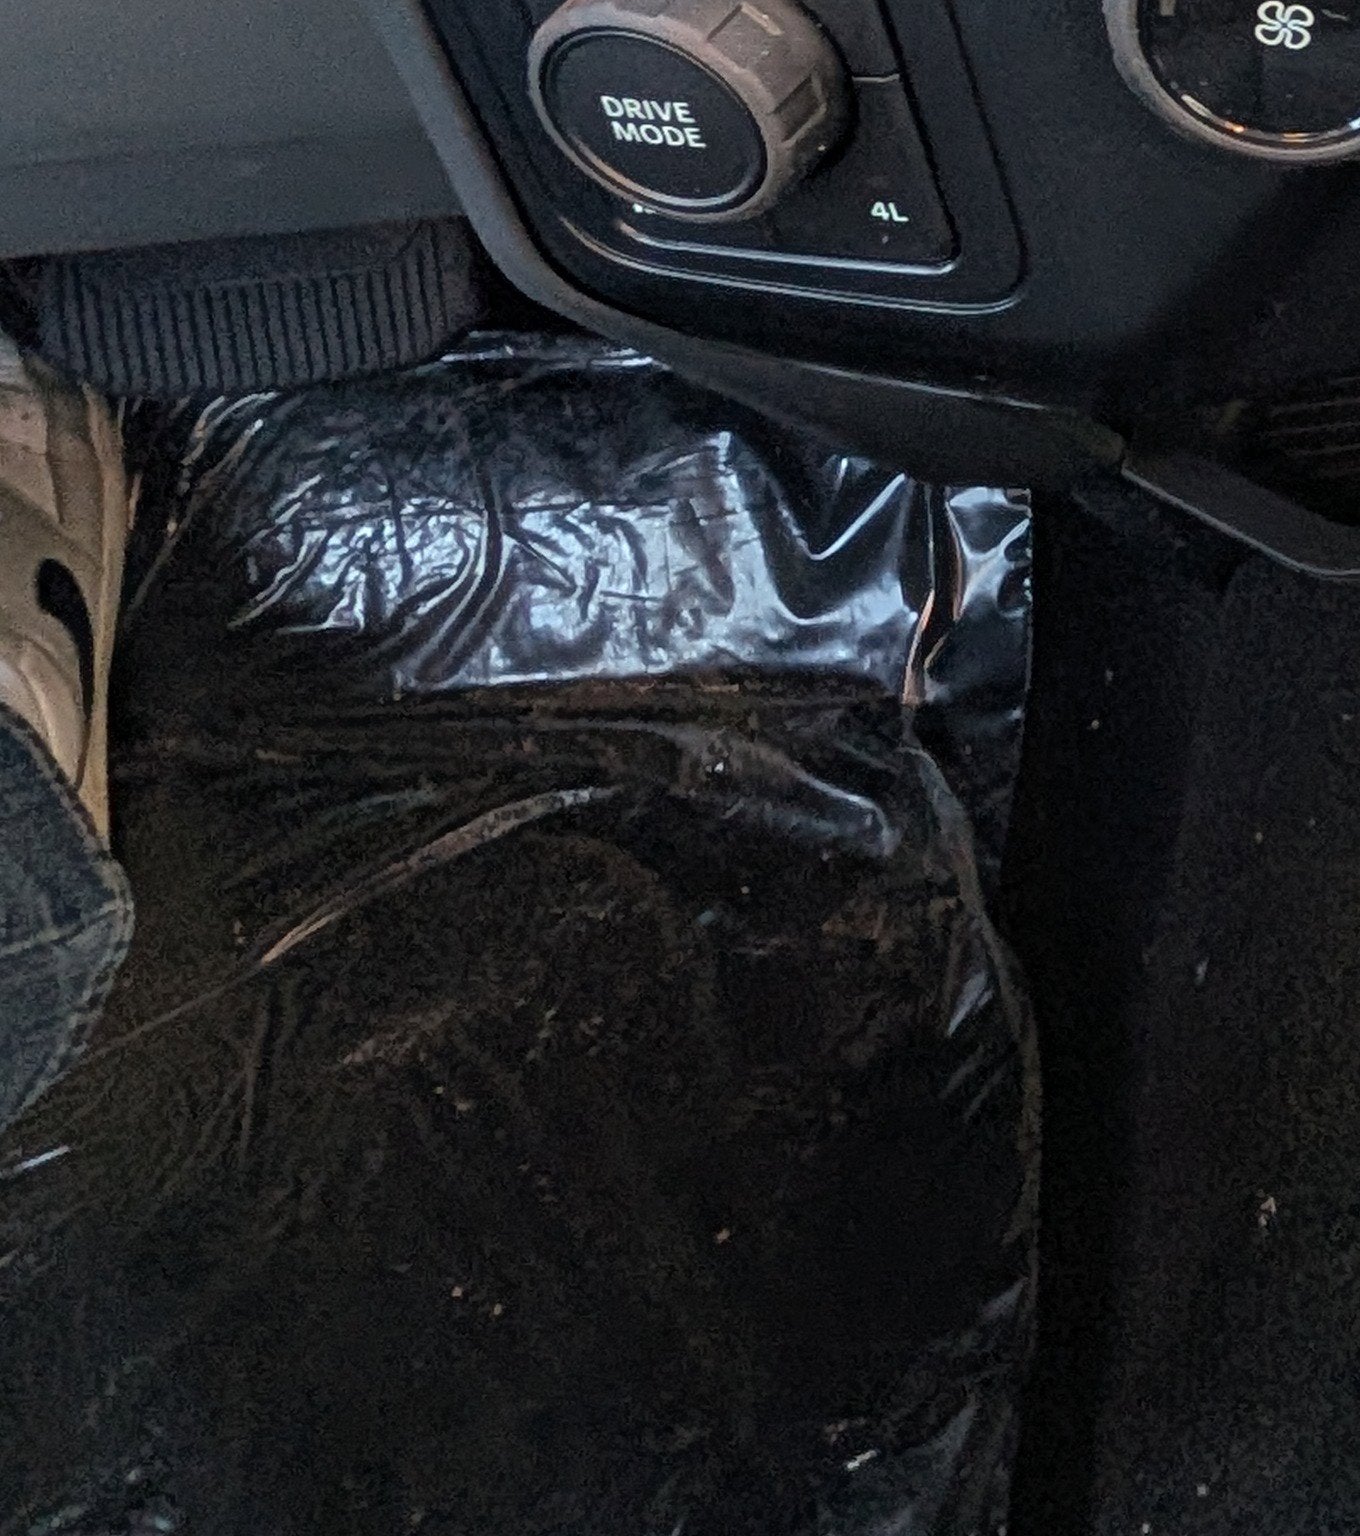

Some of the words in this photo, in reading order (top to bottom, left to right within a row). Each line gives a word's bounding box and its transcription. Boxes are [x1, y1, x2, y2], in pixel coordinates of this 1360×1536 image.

[600, 94, 697, 125] DRIVE
[612, 120, 708, 150] MODE
[870, 201, 909, 223] 4L
